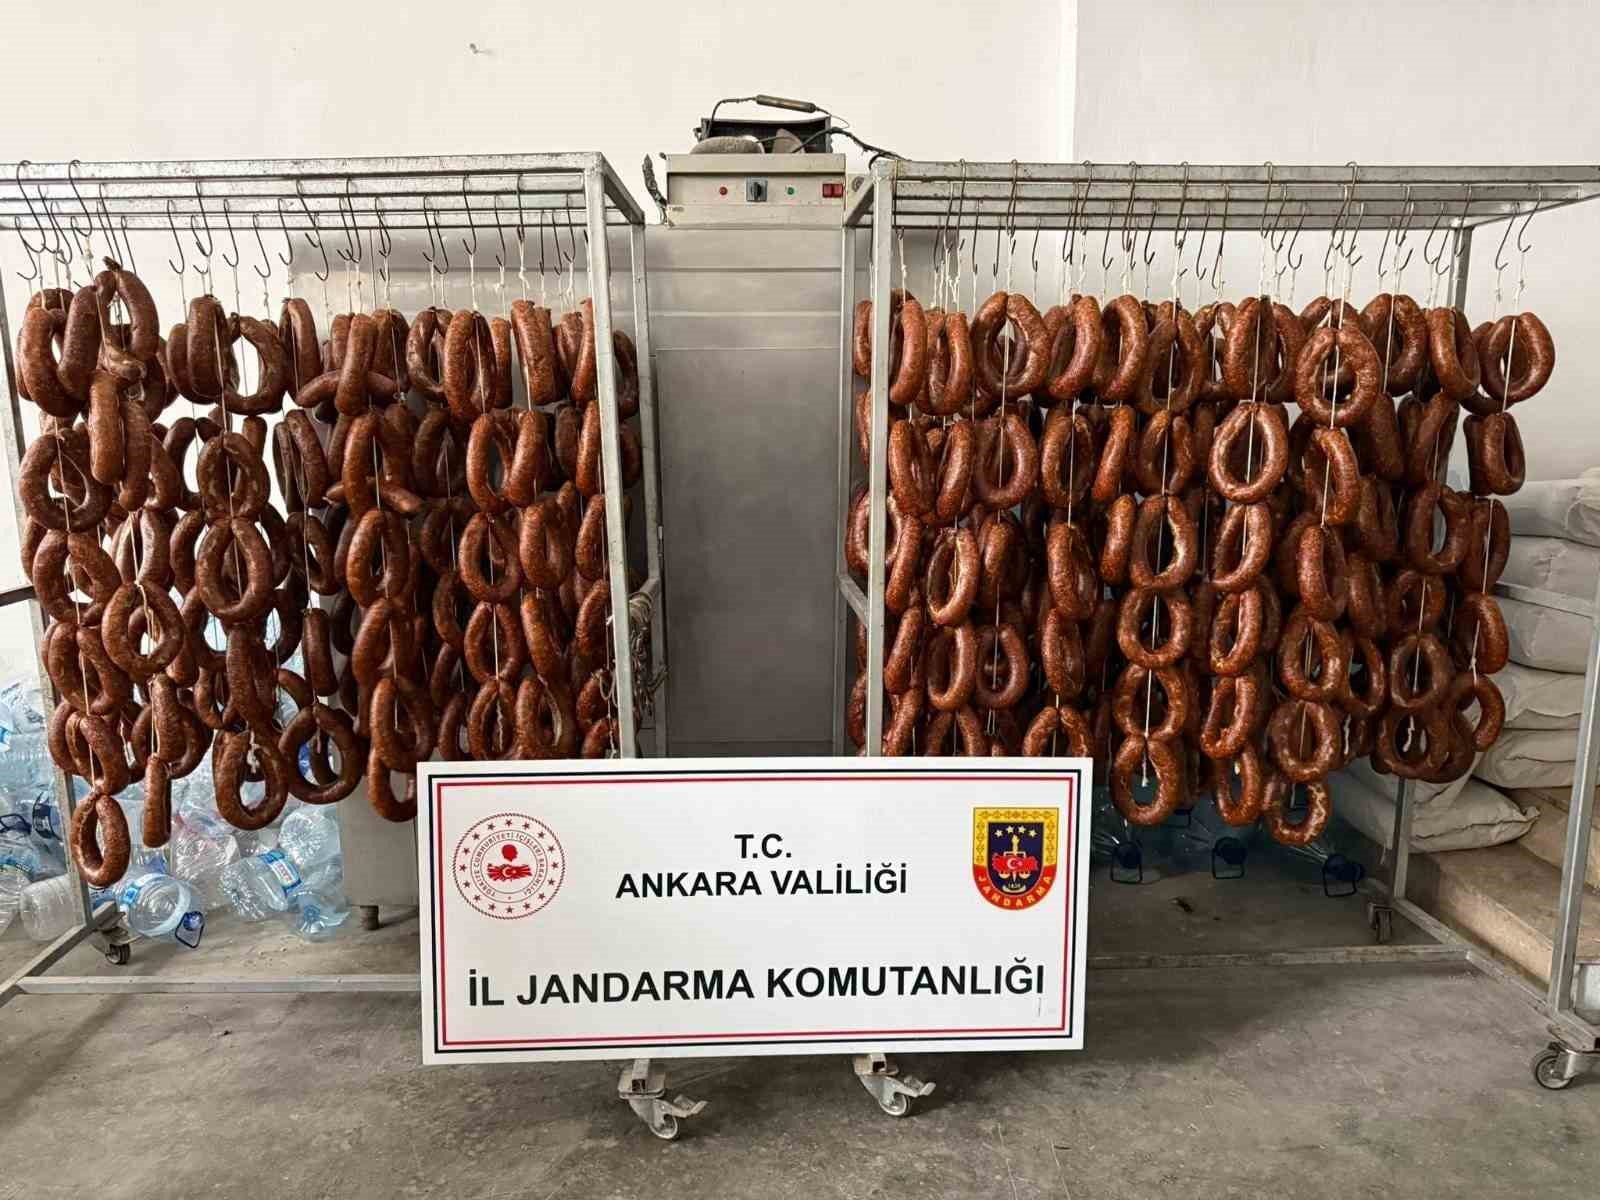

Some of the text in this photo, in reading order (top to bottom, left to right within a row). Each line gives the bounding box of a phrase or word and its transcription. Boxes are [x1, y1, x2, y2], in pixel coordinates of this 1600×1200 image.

[734, 833, 792, 859] T.C.
[615, 862, 907, 899] ANKARA VALİLİĞİ
[977, 875, 1053, 908] JANDARMA
[469, 956, 1044, 1007] İL JANDARMA KOMUTANLIĞI
